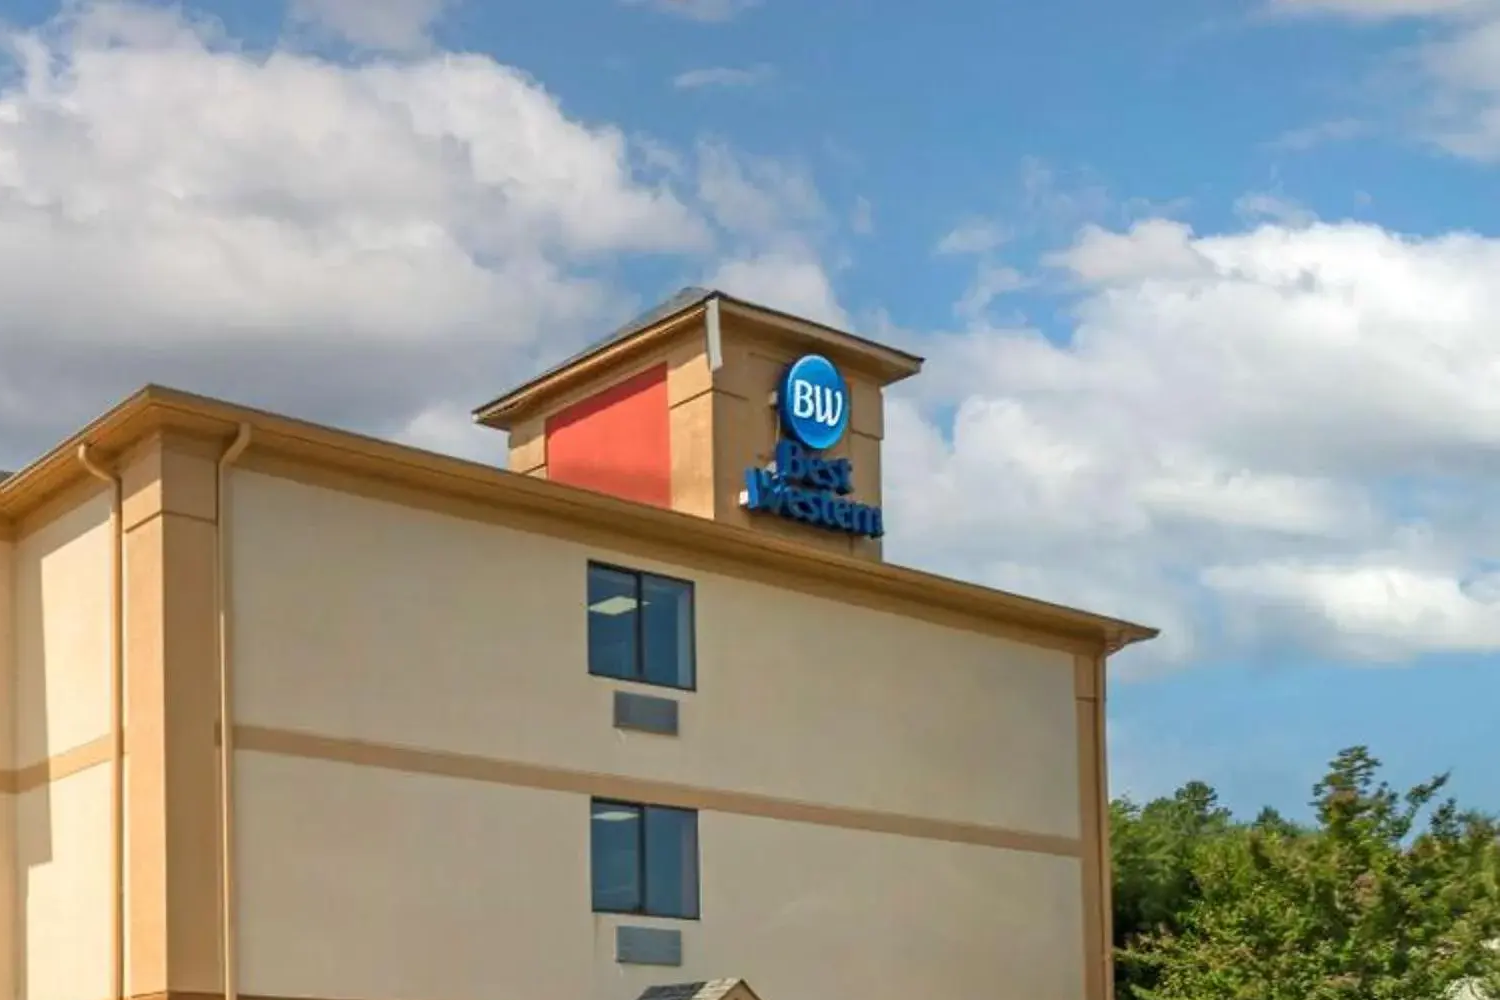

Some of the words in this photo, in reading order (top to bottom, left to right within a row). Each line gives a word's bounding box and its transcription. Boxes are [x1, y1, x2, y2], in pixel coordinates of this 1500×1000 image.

[793, 379, 843, 426] BW
[777, 440, 853, 493] Best
[745, 468, 884, 537] Western
